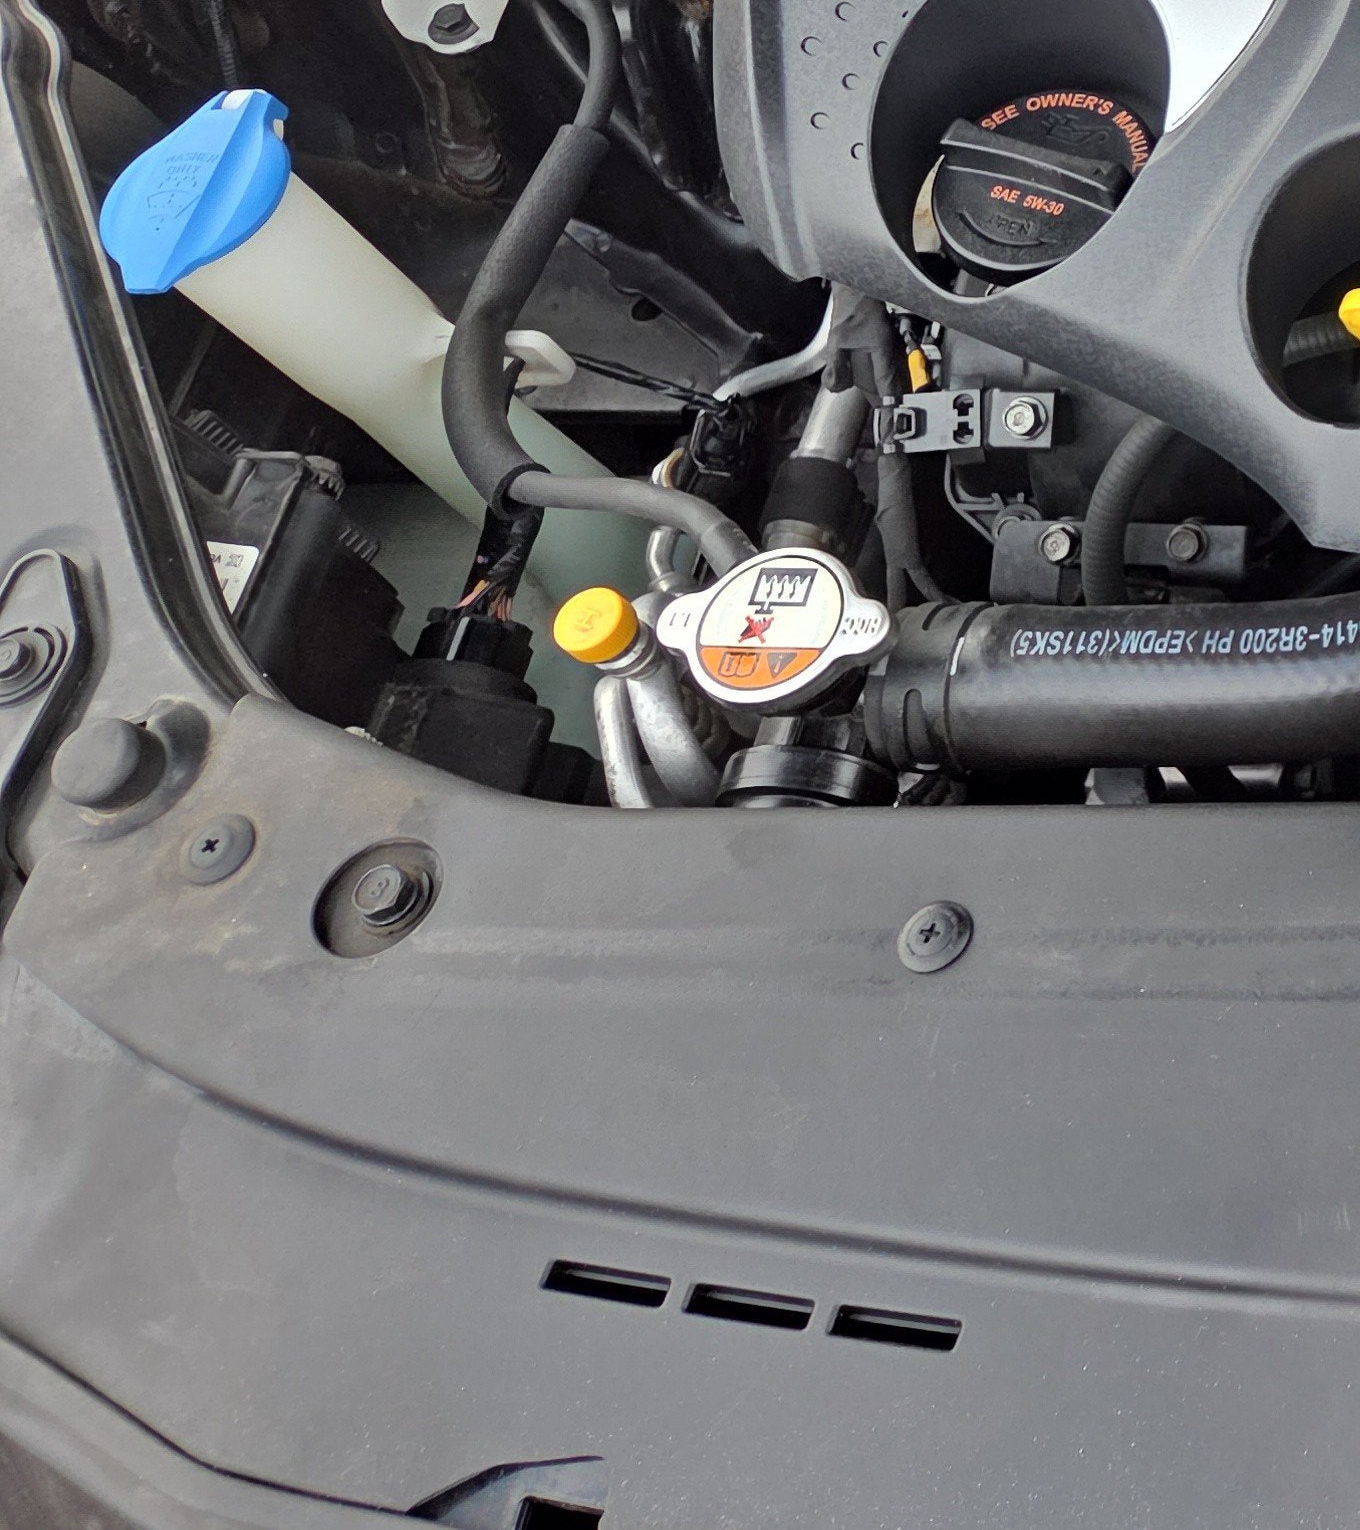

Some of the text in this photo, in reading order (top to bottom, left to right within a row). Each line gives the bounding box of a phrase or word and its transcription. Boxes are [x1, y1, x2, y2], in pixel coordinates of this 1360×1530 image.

[980, 92, 1150, 175] SEE OWNER'S MANUAL
[990, 185, 1066, 217] SAE 5W-30
[1202, 628, 1236, 655] PH
